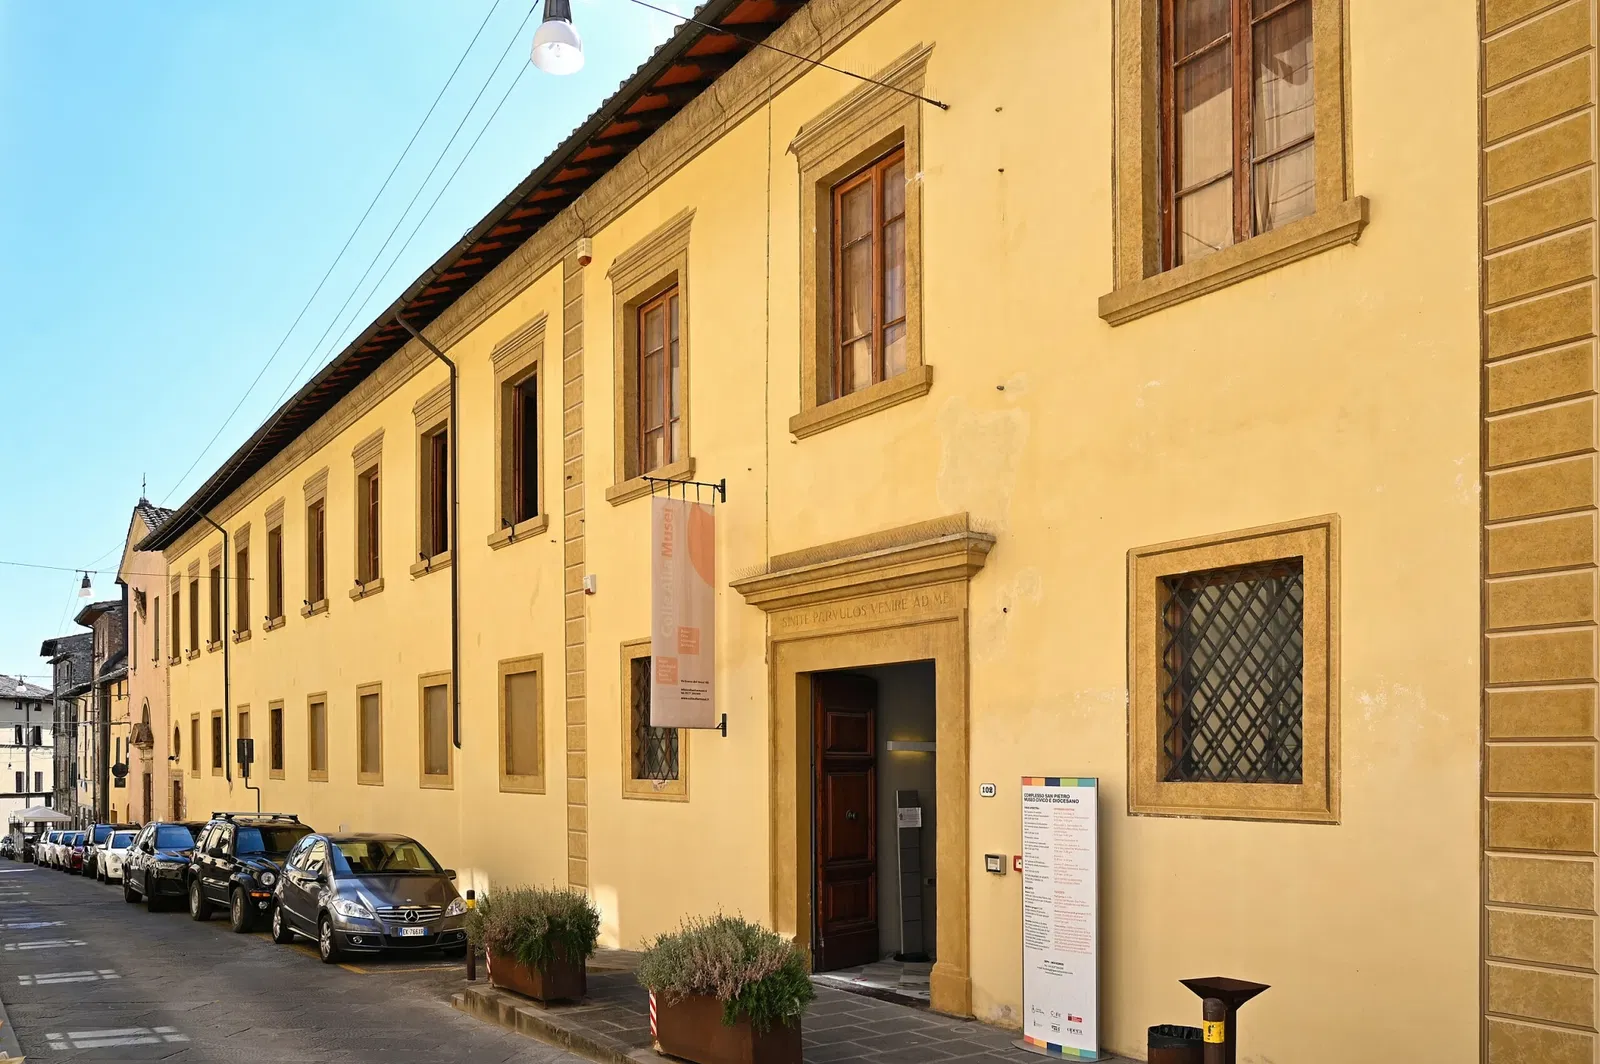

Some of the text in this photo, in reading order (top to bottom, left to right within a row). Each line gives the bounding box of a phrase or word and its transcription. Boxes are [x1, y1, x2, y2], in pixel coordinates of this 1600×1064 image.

[781, 591, 951, 628] SINITE PARVULOS VENIRE AD ME
